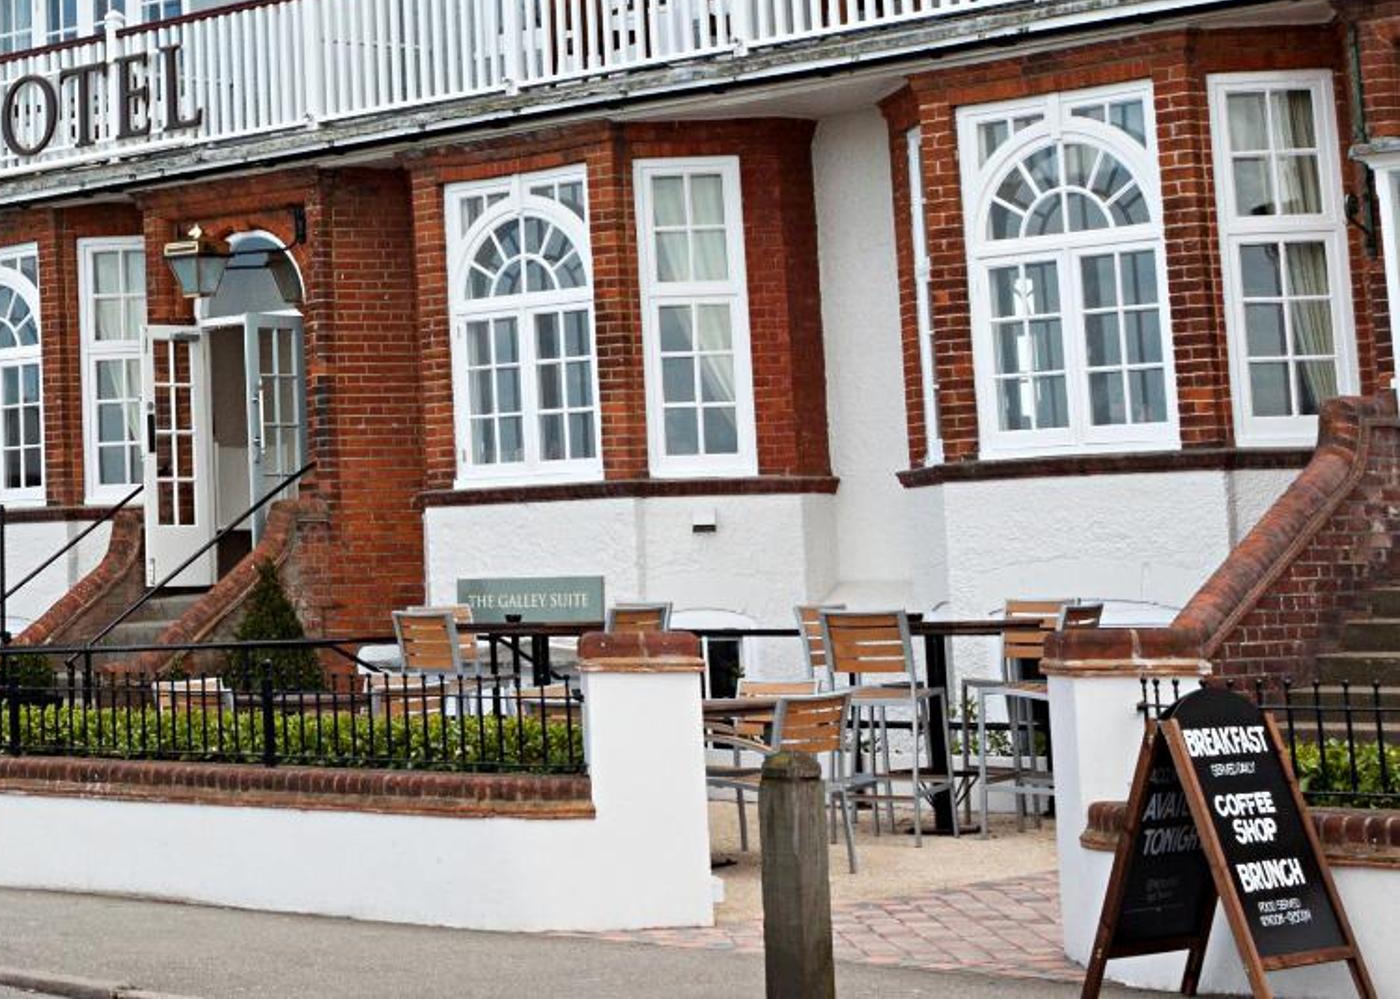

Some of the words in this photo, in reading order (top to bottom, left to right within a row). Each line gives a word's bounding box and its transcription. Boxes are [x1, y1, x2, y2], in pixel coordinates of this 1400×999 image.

[468, 594, 496, 609] THE
[498, 593, 546, 609] GALLEY
[549, 591, 590, 609] SUITE
[1182, 725, 1269, 758] BREAKFAST
[1214, 791, 1277, 817] COFFEE
[1142, 824, 1202, 856] TONIGH
[1232, 817, 1277, 845] SHOP
[1235, 858, 1306, 893] BRUNCH
